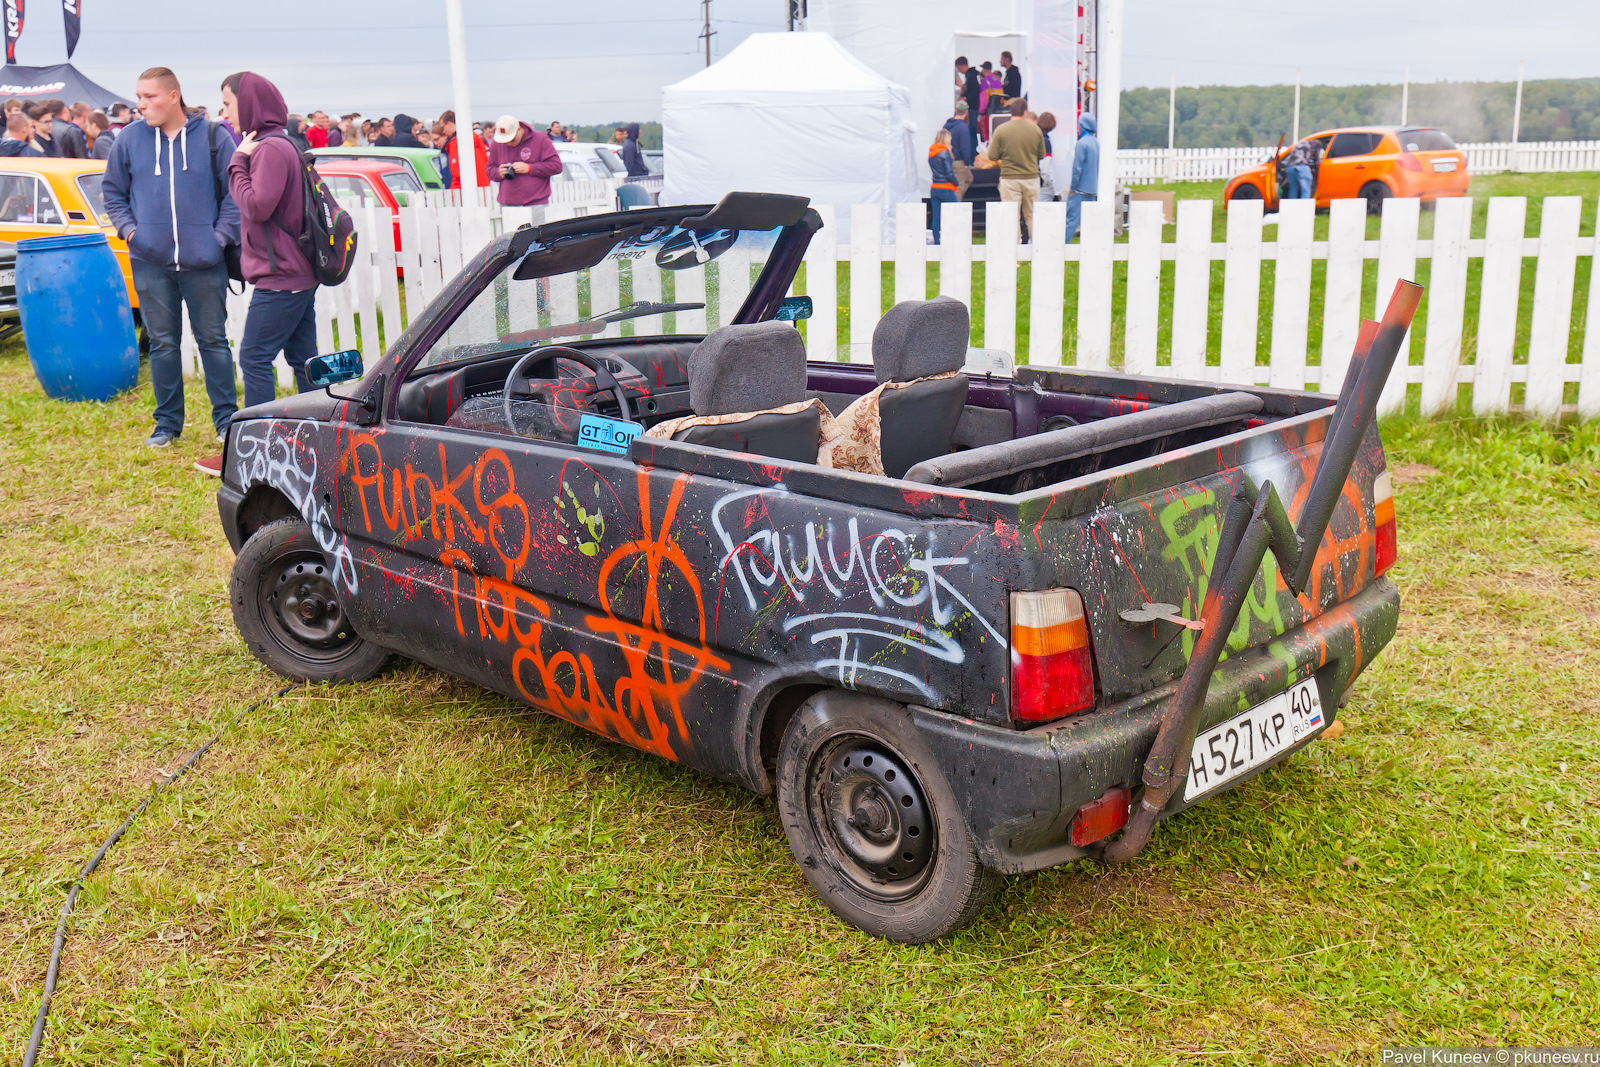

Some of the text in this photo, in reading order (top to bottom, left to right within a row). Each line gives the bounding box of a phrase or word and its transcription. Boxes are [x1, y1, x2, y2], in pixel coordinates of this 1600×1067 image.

[581, 424, 601, 438] GT
[1291, 686, 1312, 719] 40
[1294, 719, 1311, 736] RUS
